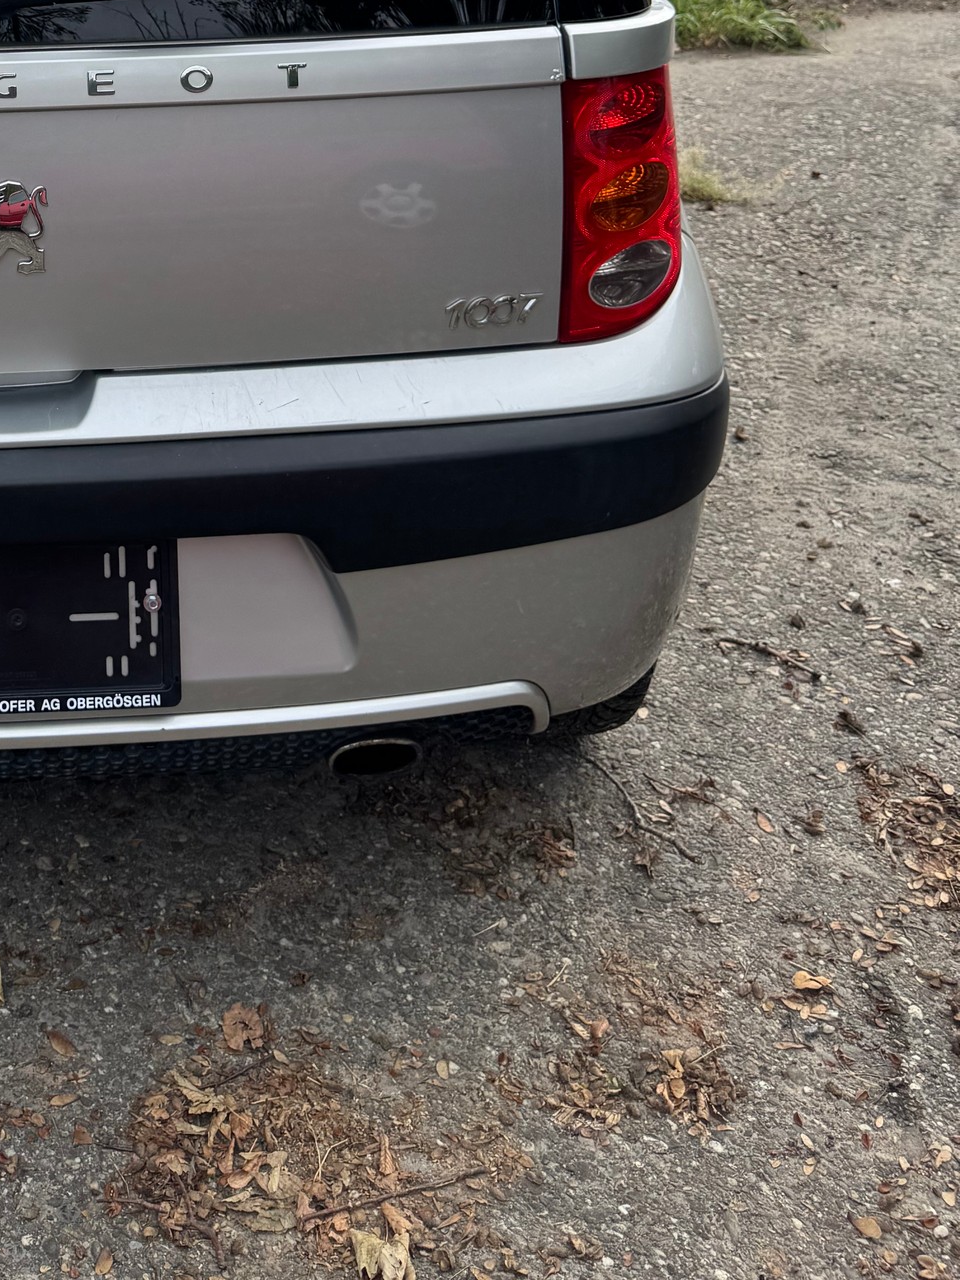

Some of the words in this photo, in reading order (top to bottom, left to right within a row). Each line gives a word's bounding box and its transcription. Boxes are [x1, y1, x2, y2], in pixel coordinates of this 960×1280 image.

[444, 291, 545, 331] 1007
[40, 698, 61, 711] AG
[66, 693, 161, 710] OBERGÖSGEN
